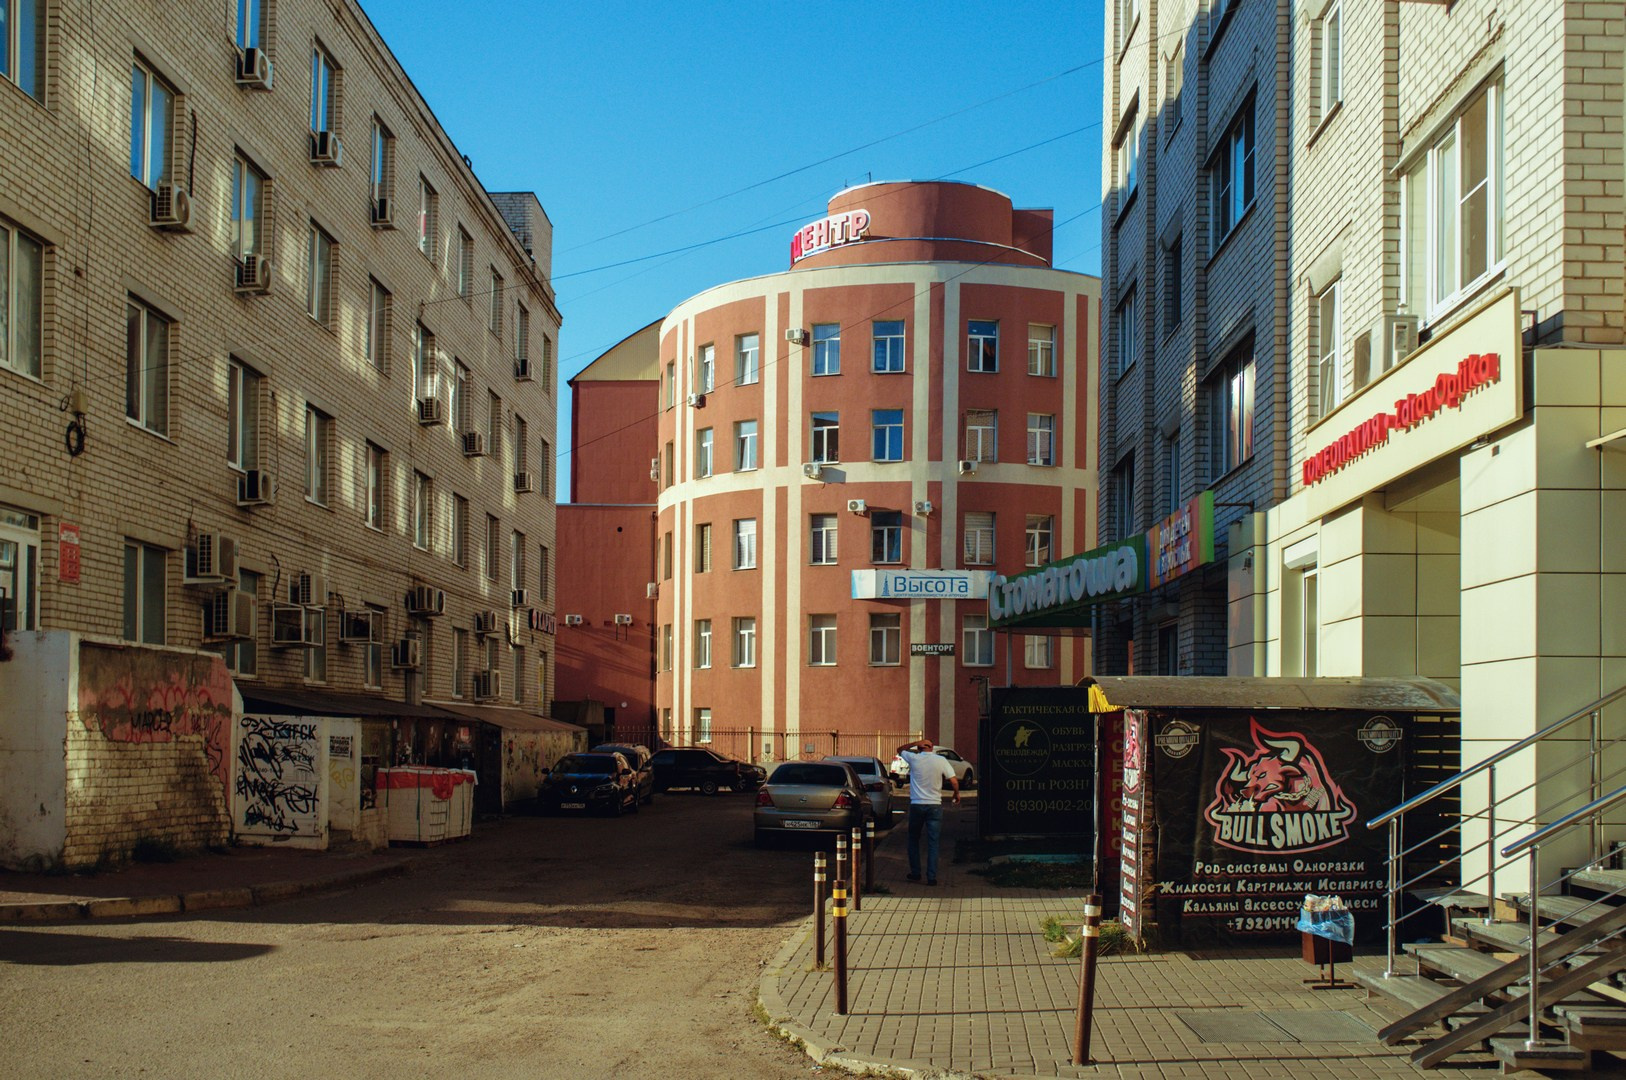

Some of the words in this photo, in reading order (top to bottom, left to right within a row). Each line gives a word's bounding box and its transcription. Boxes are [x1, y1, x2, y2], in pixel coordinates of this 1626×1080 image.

[1303, 413, 1387, 485] ГОМЕОПАТИЯ
[990, 546, 1137, 621] Стоматоша
[911, 644, 954, 652] ВОЕНТОРГ
[1002, 705, 1075, 714] ТАКТИЧЕСКАЯ
[1052, 726, 1085, 736] ОБУВЬ
[996, 749, 1048, 757] СПЕЦОДЕЖДА
[1006, 779, 1035, 790] ОПТ
[1221, 814, 1268, 846] BULL
[1270, 812, 1342, 849] SMOKE
[1293, 859, 1365, 873] Одноразки
[1159, 880, 1231, 895] Жидкости
[1236, 879, 1312, 893] Картриджи
[1183, 899, 1239, 913] Кальяны
